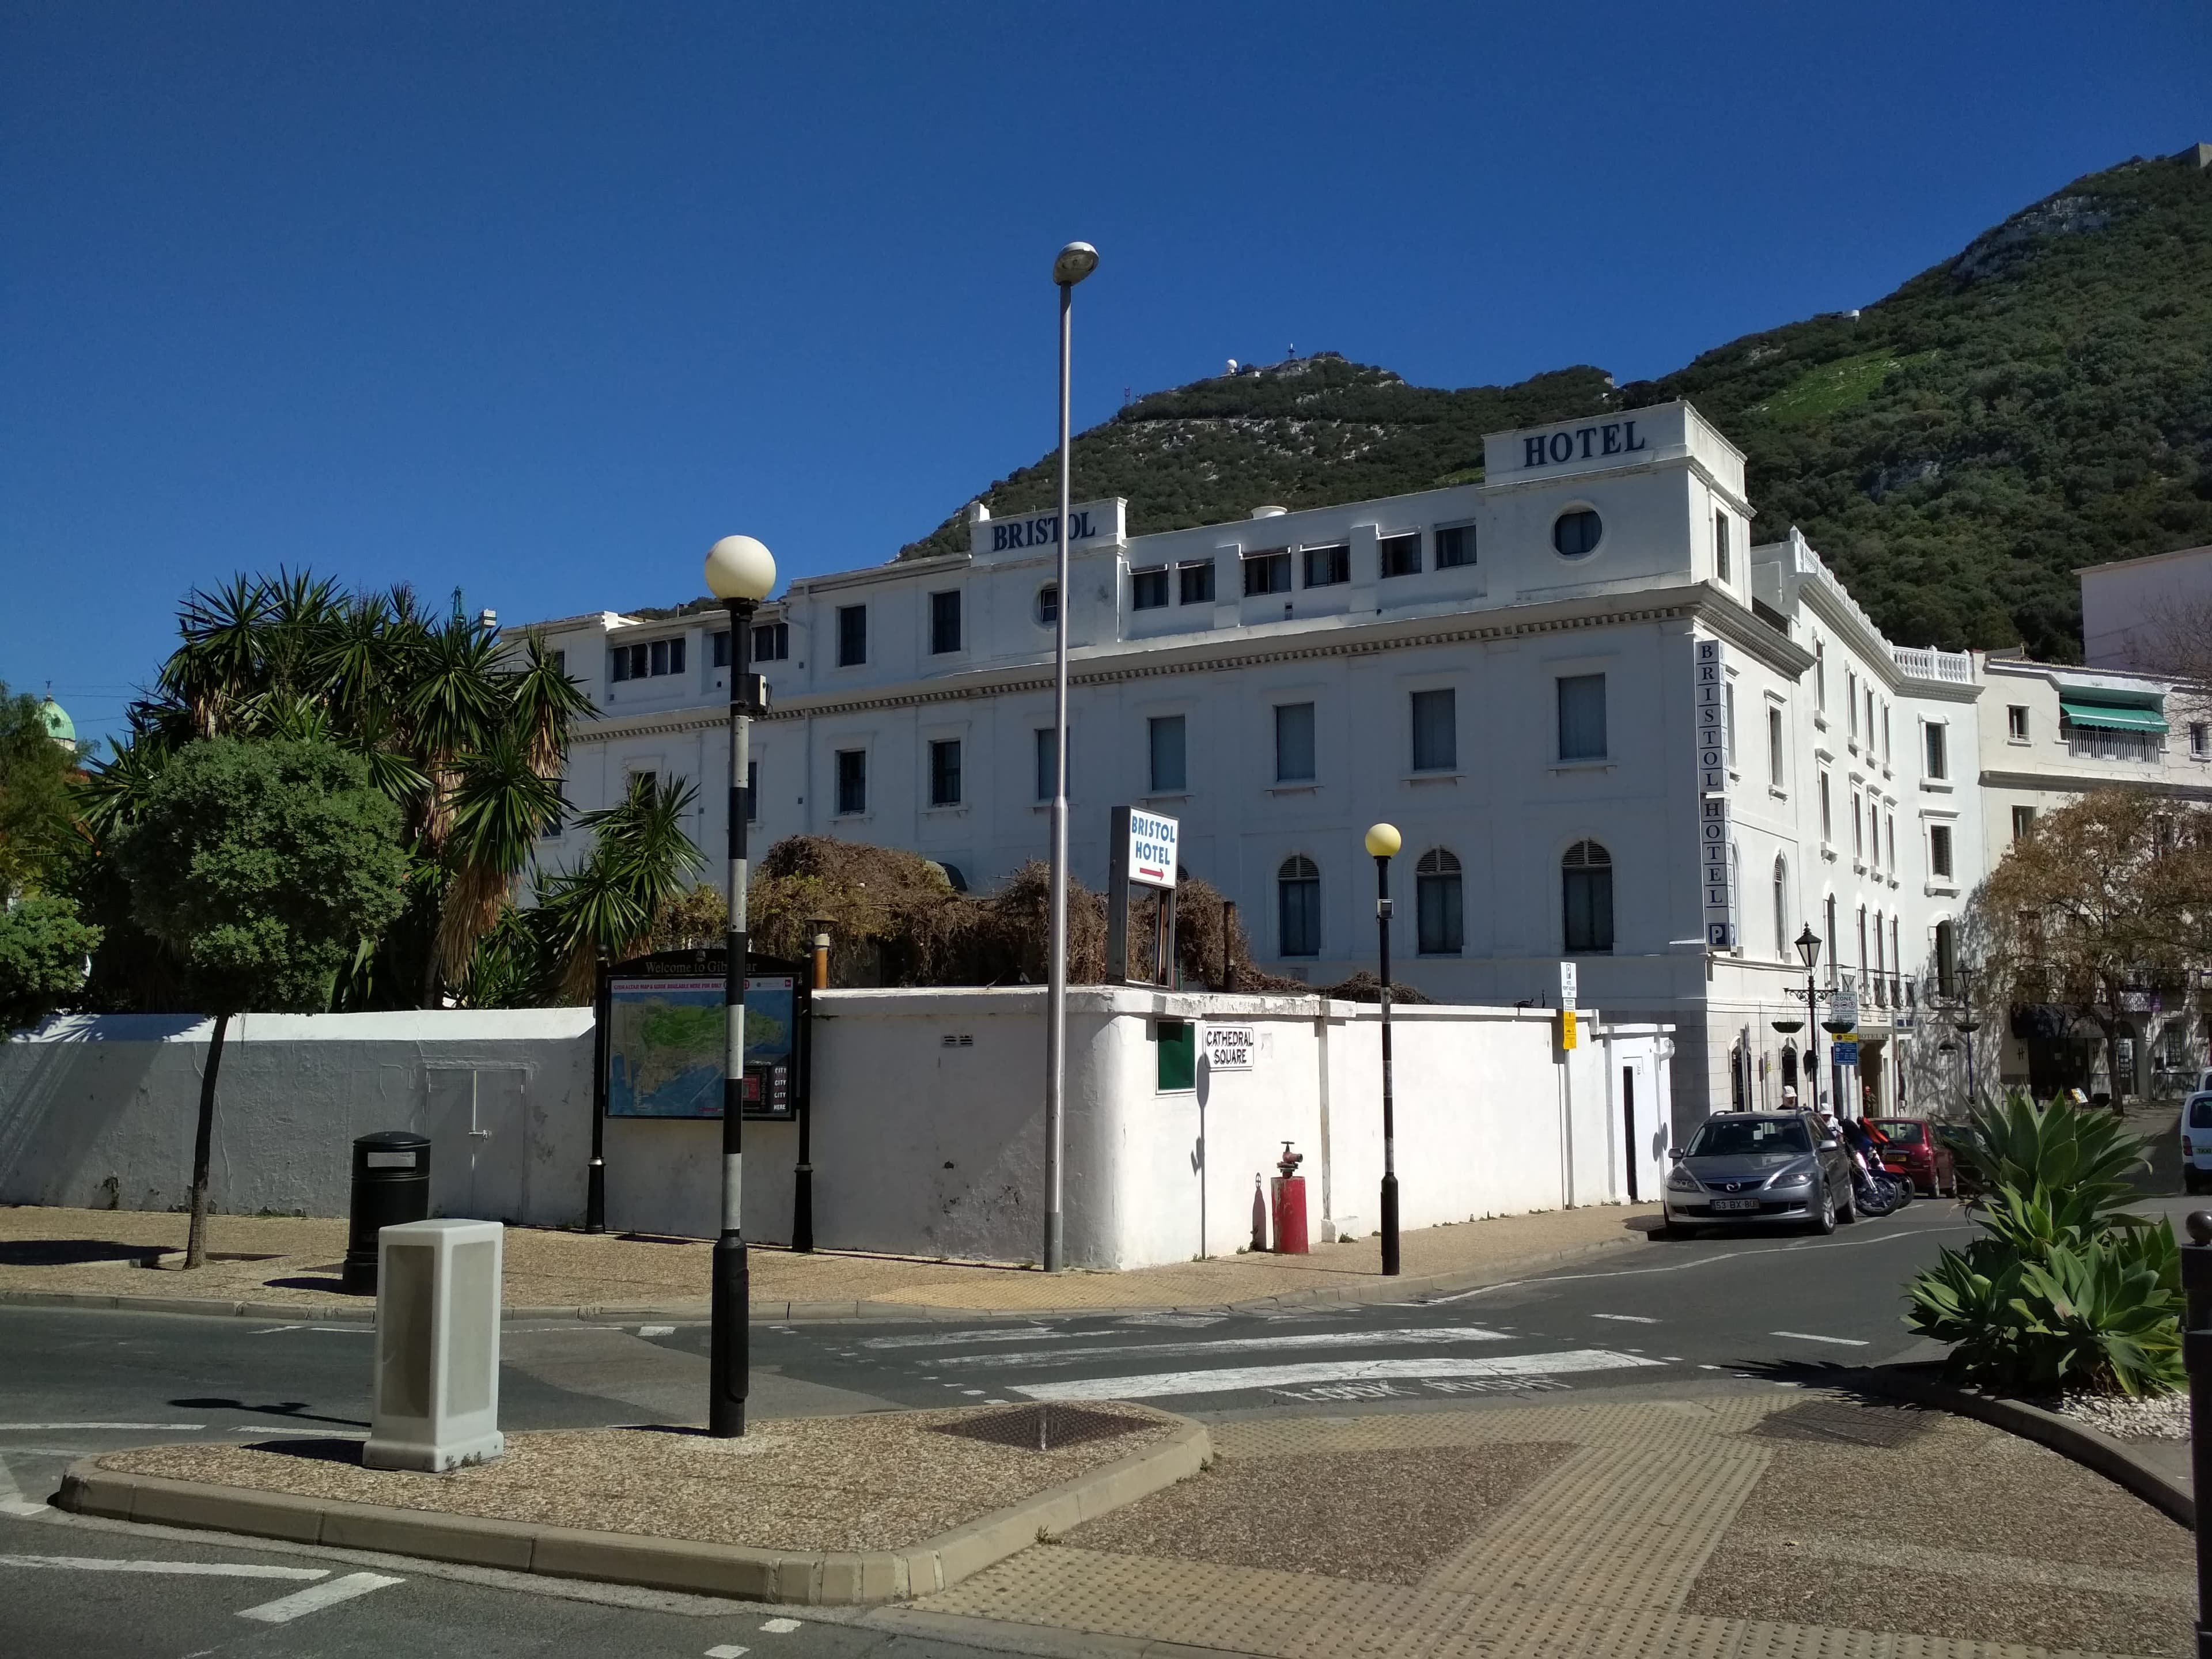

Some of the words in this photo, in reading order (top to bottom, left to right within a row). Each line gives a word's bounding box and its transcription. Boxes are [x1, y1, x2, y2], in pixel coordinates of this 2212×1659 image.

[1523, 421, 1645, 467] HOTEL
[992, 512, 1096, 551] BRISTOL
[1701, 645, 1718, 786] BRISTOL
[1719, 645, 1729, 788] BRISTOL
[1725, 802, 1733, 904] HOTEL
[1131, 815, 1176, 843] BRISTOL
[1135, 840, 1171, 865] HOTEL
[1704, 802, 1723, 904] HOTEL
[1711, 925, 1724, 944] P
[645, 961, 691, 973] Welcome
[695, 962, 705, 972] to
[707, 961, 757, 972] Gibar
[1206, 1031, 1253, 1047] CATHEDRAL
[1213, 1048, 1247, 1065] SQUARE
[1260, 1380, 1420, 1400] LOOK
[1420, 1374, 1573, 1393] RIGHT
